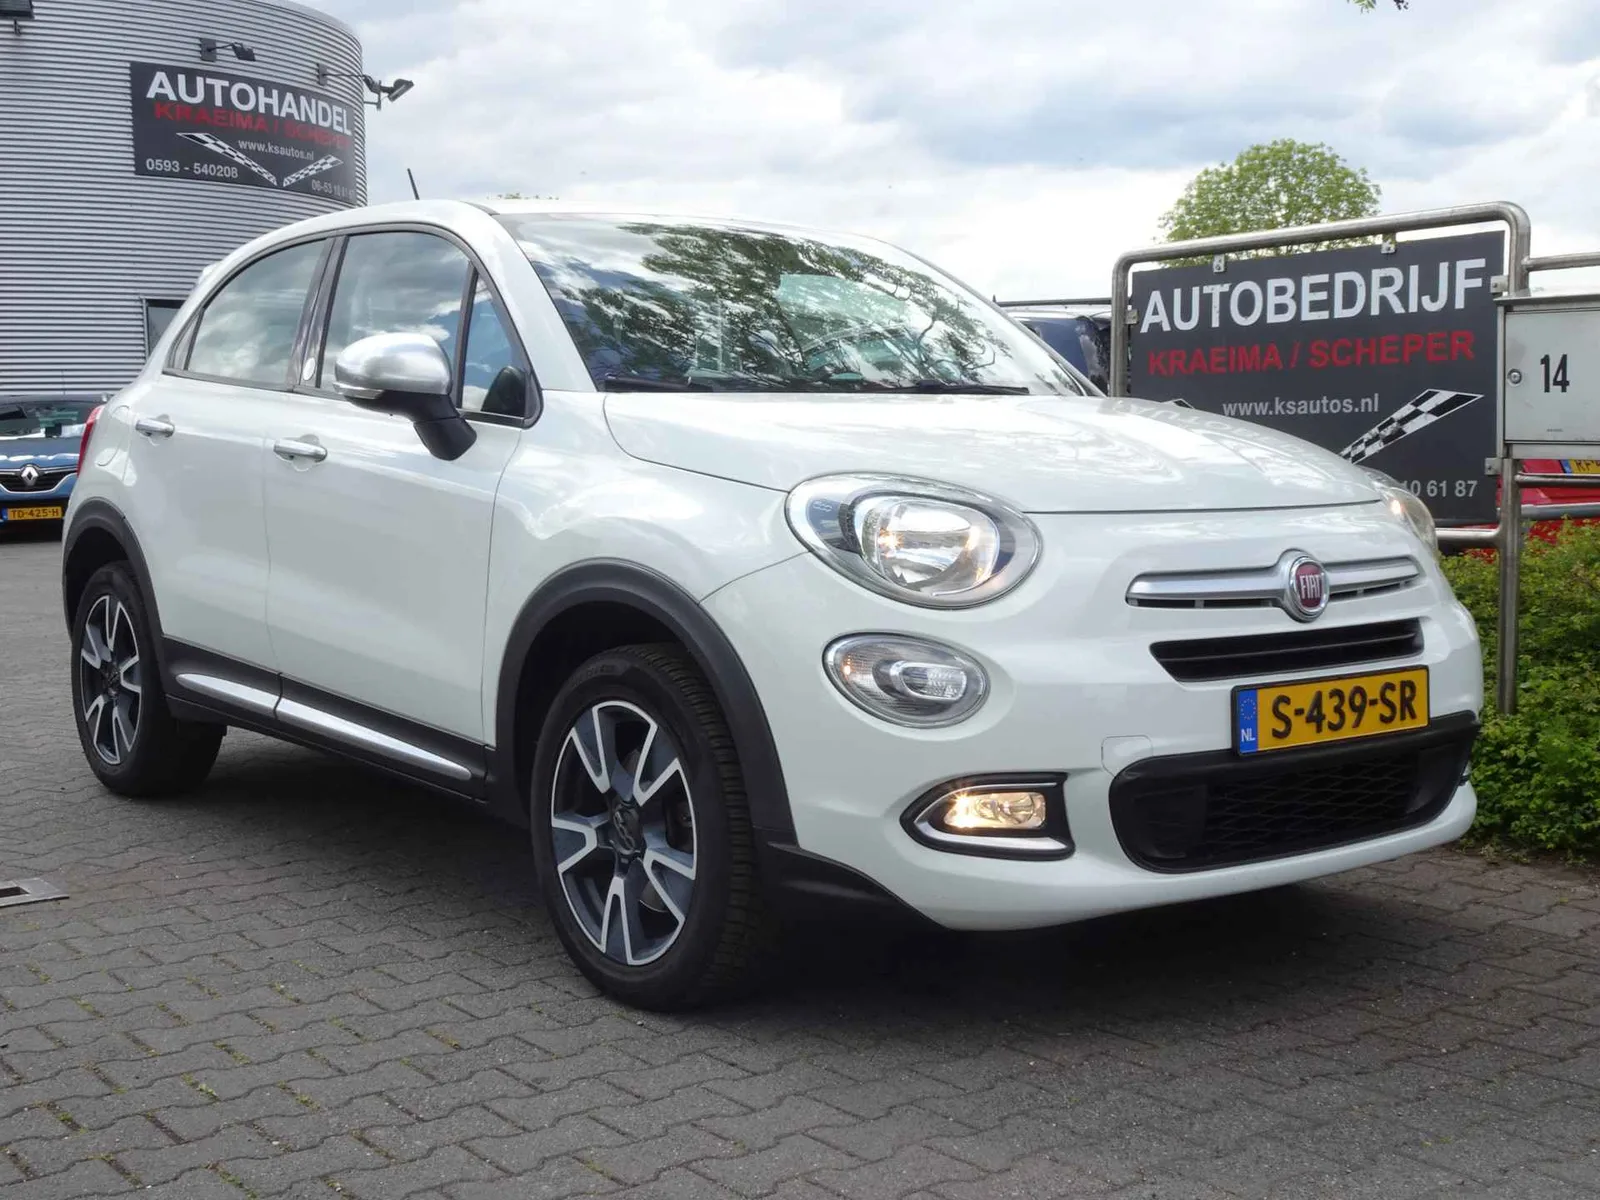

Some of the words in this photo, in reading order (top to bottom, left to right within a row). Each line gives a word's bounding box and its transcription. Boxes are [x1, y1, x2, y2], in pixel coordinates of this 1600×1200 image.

[146, 71, 352, 136] AUTOHANDEL
[155, 102, 271, 132] KRAEIMA
[238, 139, 315, 161] www.ksautos.nl
[146, 158, 180, 173] 0593
[193, 162, 238, 179] 540208
[1140, 257, 1487, 334] AUTOBEDRIJF
[1148, 341, 1283, 377] KRAEIMA
[1289, 342, 1300, 369] /
[1309, 330, 1475, 369] SCHEPER
[1540, 353, 1570, 394] 14
[1223, 392, 1379, 418] www.ksautos.nl
[1426, 480, 1447, 497] 61
[1454, 480, 1478, 497] 87
[11, 508, 59, 519] TD-425-H
[1299, 574, 1323, 599] FIAT
[1272, 680, 1418, 740] S-439-SR
[1240, 728, 1256, 742] NL
